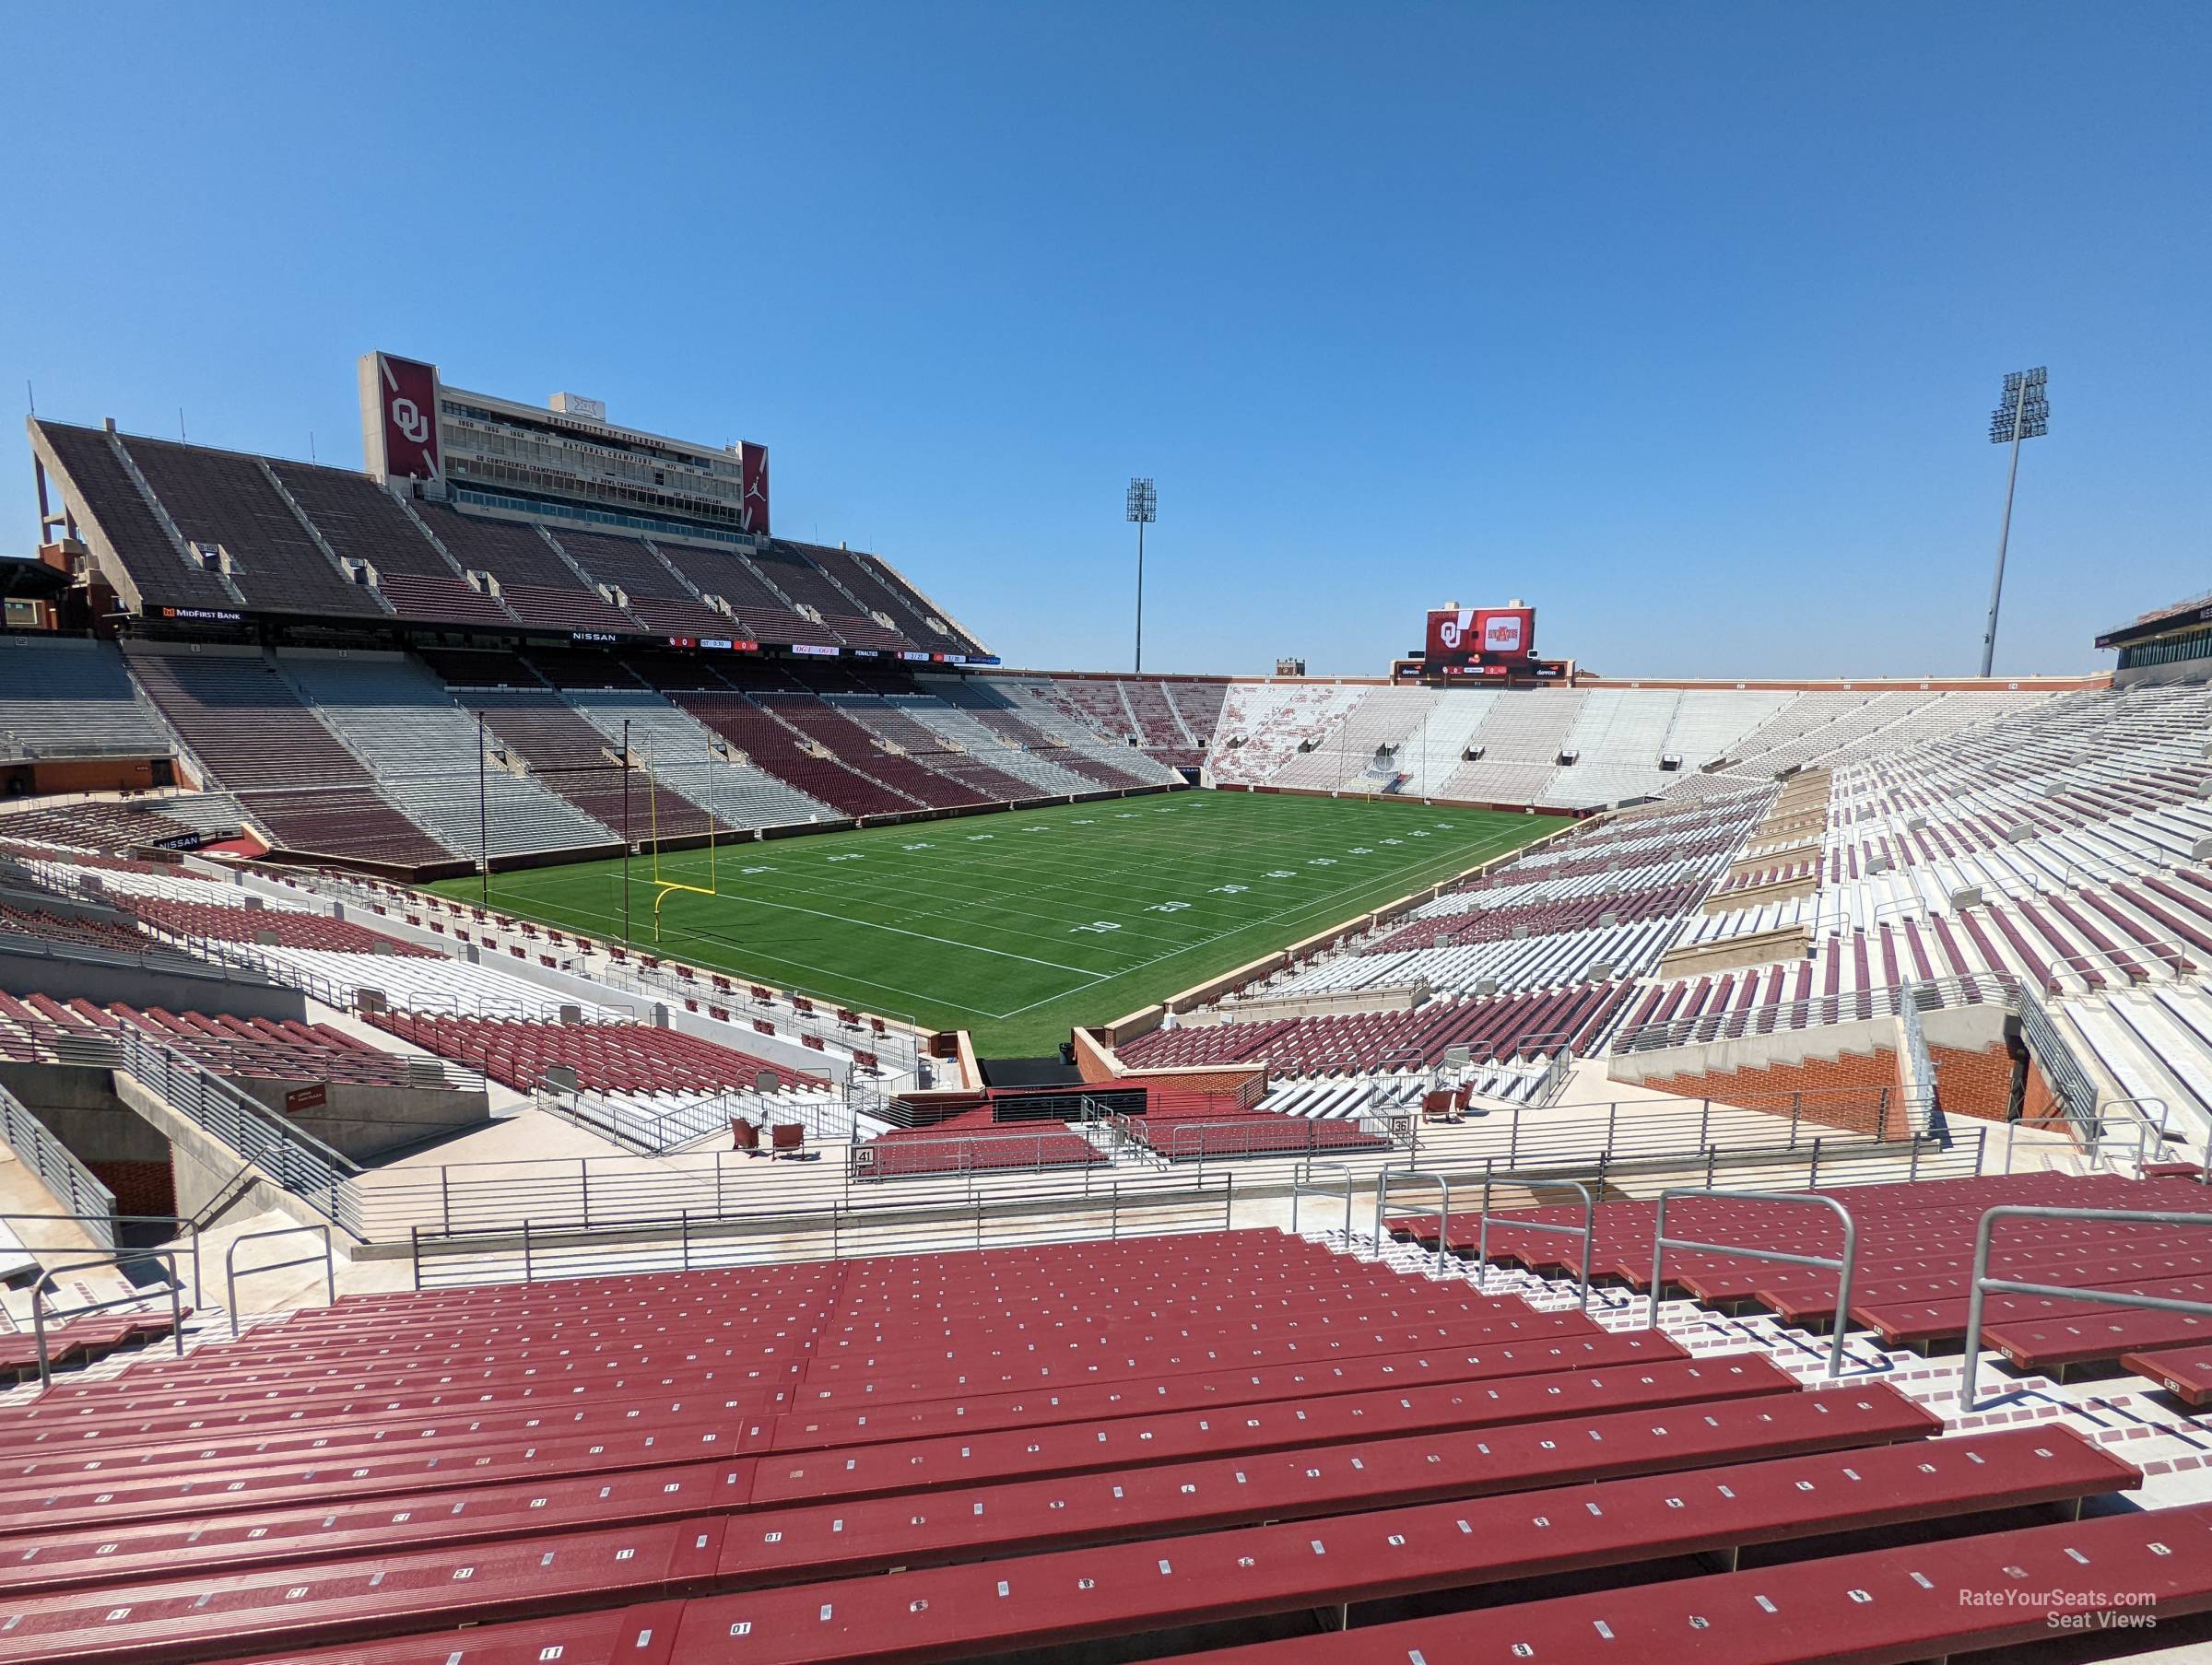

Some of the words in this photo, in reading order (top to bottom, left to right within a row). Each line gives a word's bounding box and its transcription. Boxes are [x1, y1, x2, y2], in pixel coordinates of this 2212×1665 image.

[393, 398, 429, 443] OU
[547, 416, 603, 434] UNIVERSITY
[622, 433, 666, 449] OKLAHOMA
[563, 441, 604, 457] NATIONAL
[608, 451, 652, 465] CHAMPIONS
[573, 632, 616, 641] NISSAN
[1441, 622, 1461, 649] OU
[159, 836, 198, 850] NISSAN
[1149, 901, 1192, 913] 20
[1394, 1120, 1407, 1131] 36
[858, 1151, 870, 1162] 41
[767, 1533, 780, 1542] 10
[619, 1550, 631, 1559] 11
[457, 1569, 470, 1577] 12
[732, 1624, 747, 1634] 10
[544, 1647, 559, 1659] 11
